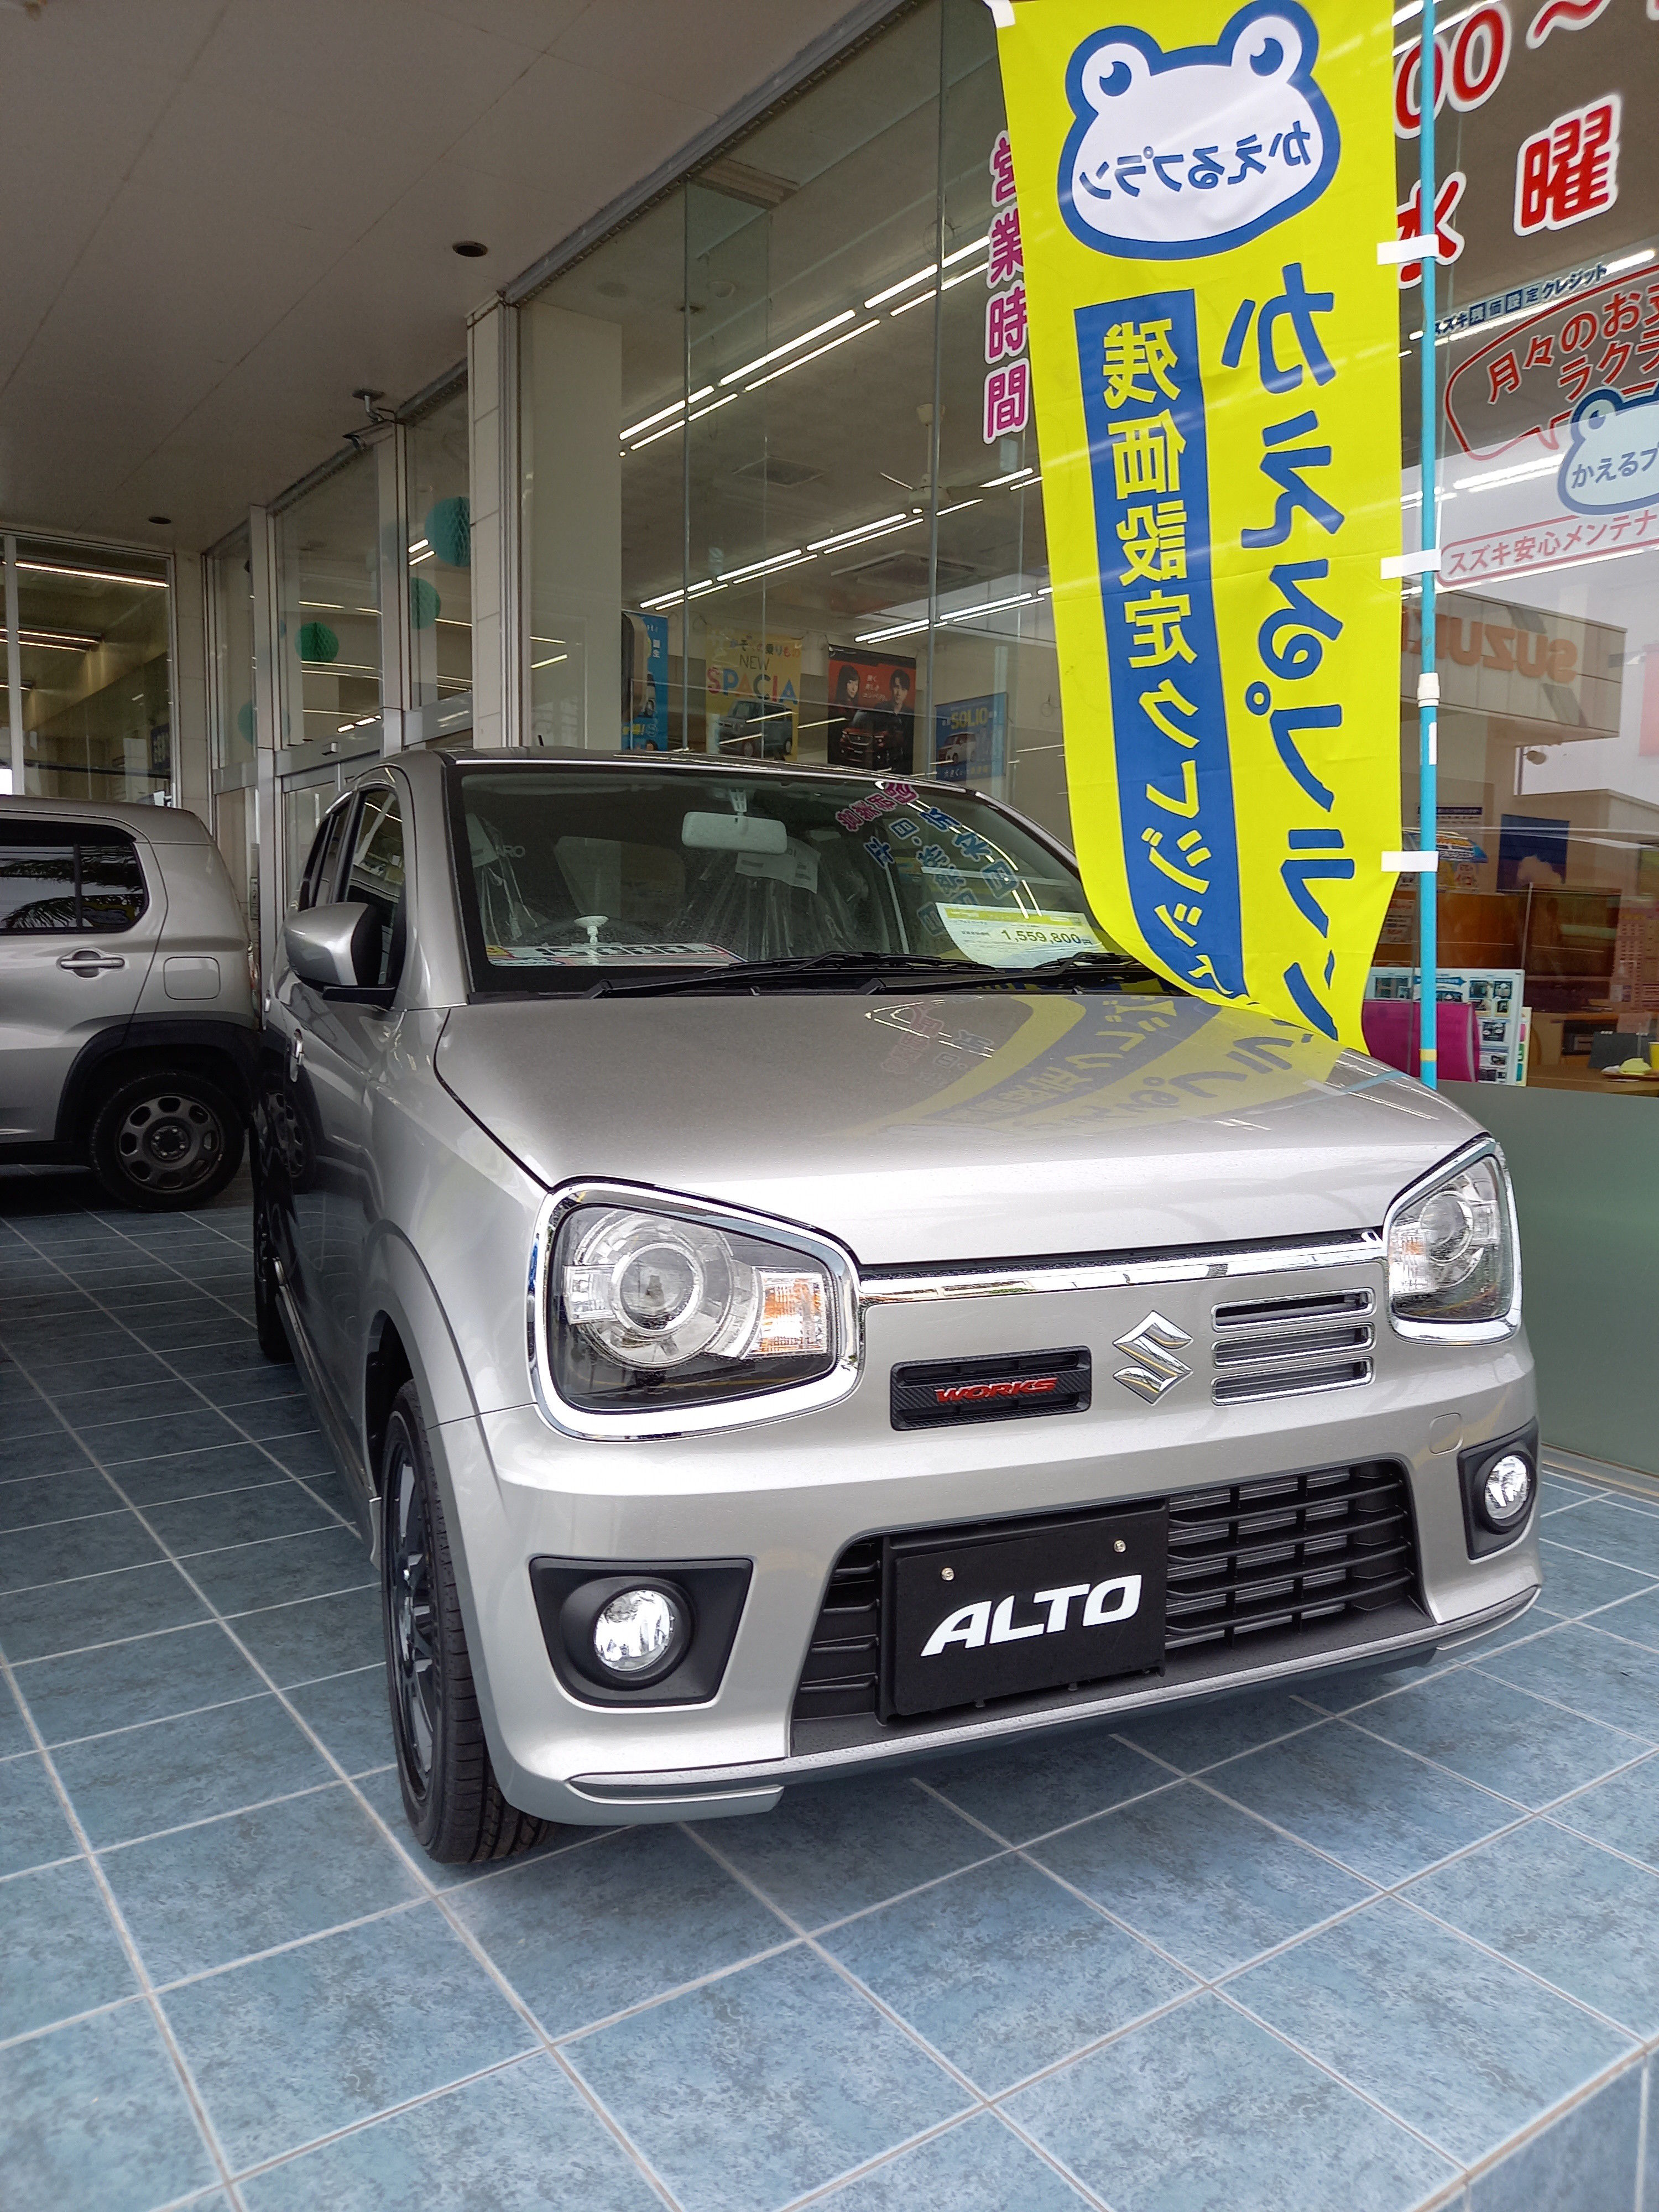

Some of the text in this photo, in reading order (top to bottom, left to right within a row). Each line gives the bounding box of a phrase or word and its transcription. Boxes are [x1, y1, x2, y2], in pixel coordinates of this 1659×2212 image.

[740, 655, 770, 671] NEW
[707, 667, 798, 705] SPACIA
[934, 1377, 1058, 1403] WORKS
[920, 1574, 1142, 1658] ALTO
